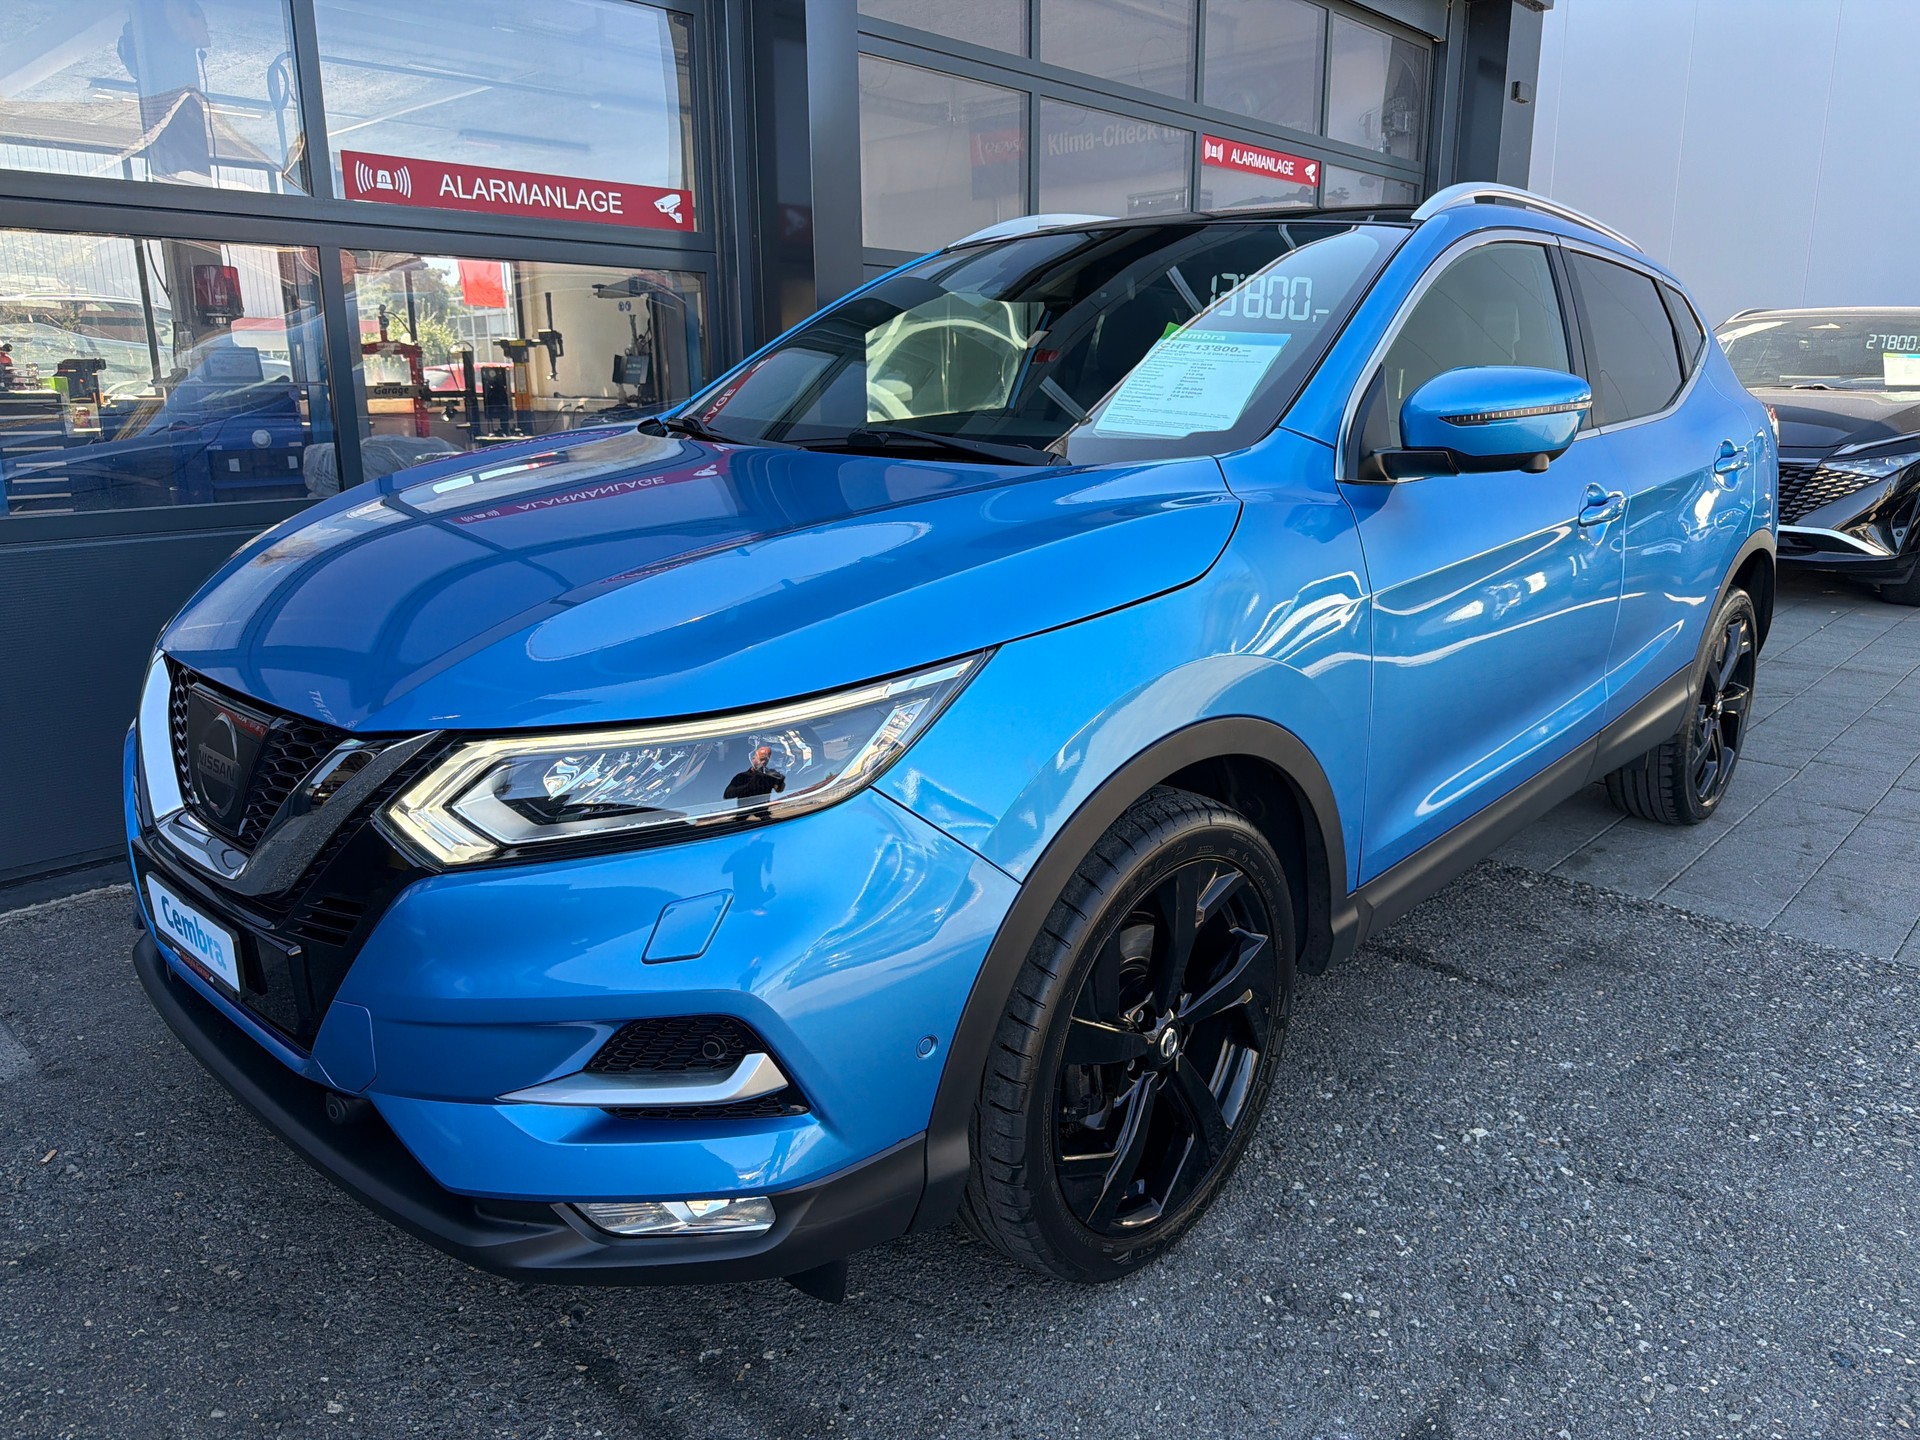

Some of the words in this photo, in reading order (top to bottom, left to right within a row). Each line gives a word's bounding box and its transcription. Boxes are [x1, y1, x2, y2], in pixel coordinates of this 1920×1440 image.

[1230, 148, 1295, 176] ALARMANLAGE
[439, 173, 624, 215] ALARMANLAGE
[374, 386, 410, 397] Garage
[199, 749, 236, 782] NISSAN
[161, 895, 228, 972] Cembra
